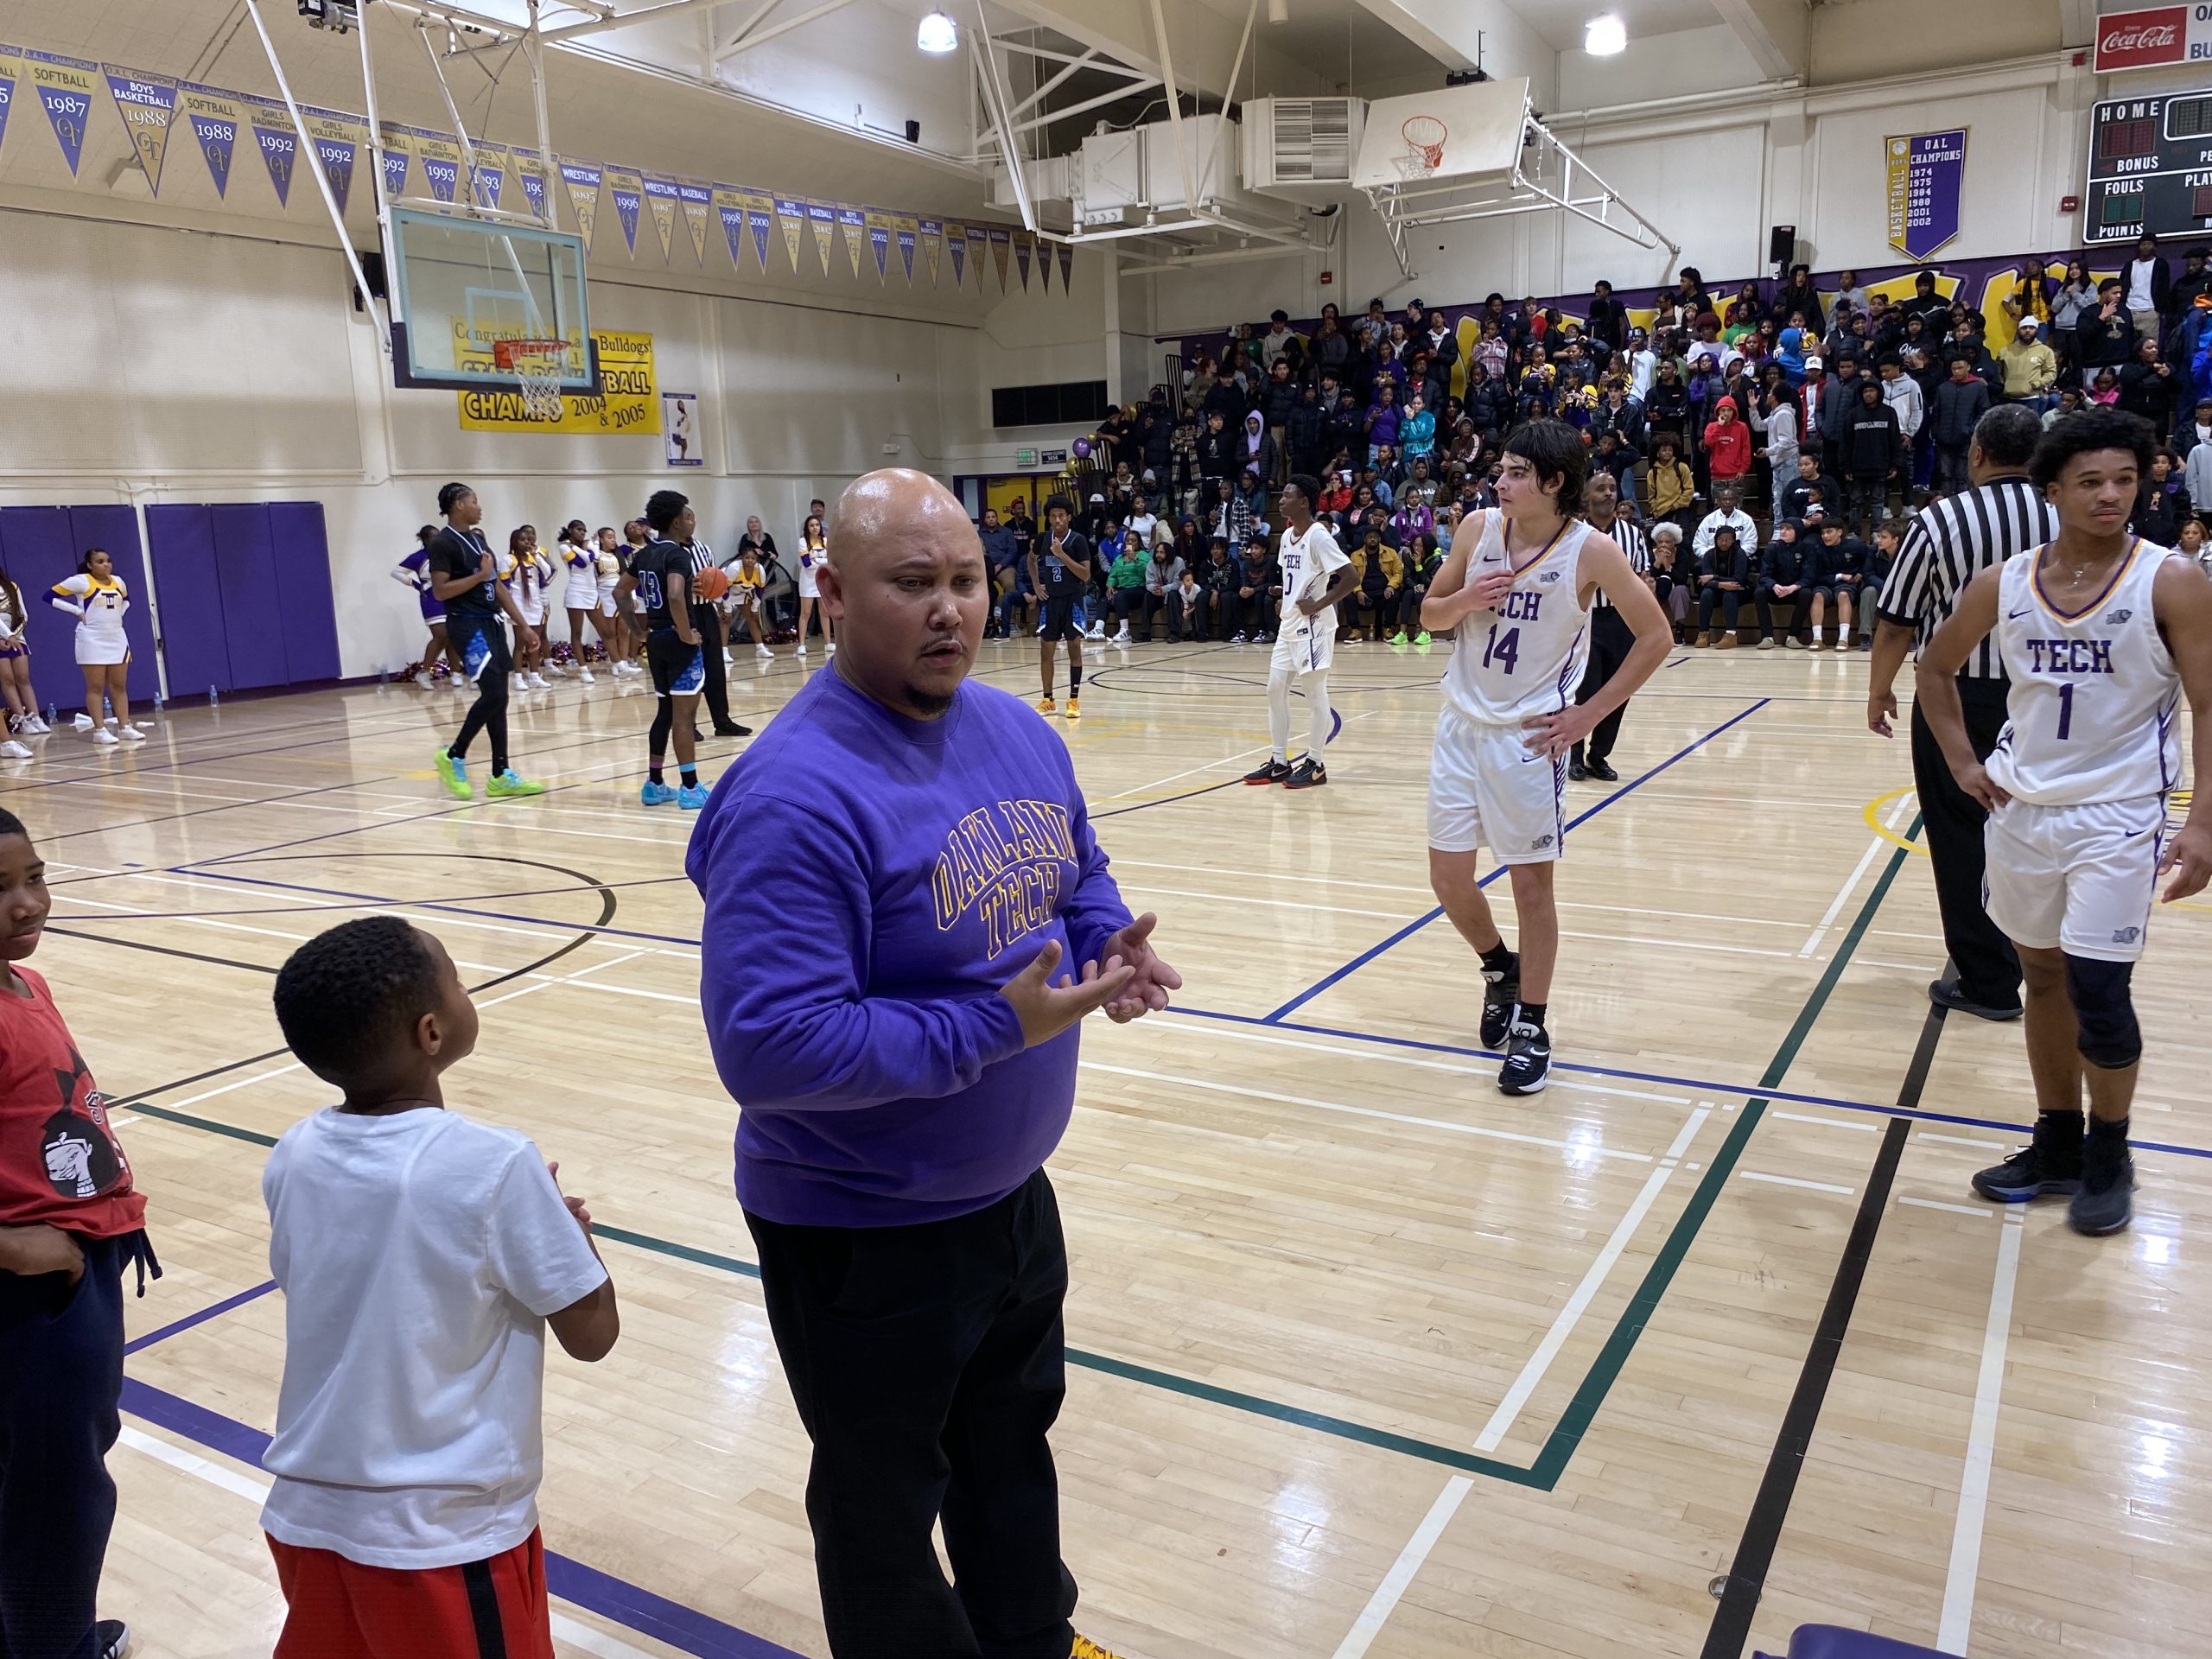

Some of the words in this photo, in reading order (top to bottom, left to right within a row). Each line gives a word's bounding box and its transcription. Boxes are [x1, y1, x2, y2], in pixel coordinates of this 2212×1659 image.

[2101, 24, 2177, 53] Coca-Cola
[50, 54, 95, 71] CHAMPIONS
[35, 67, 89, 88] SOFTBALL
[131, 72, 173, 86] CHAMPIONS
[130, 81, 155, 95] BOYS
[114, 88, 173, 109] BASKETBALL
[46, 96, 86, 118] 1987
[187, 97, 236, 117] SOFTBALL
[2101, 101, 2159, 122] HOME
[128, 109, 166, 128] 1988
[262, 110, 284, 120] GIRLS
[196, 124, 233, 141] 1988
[321, 121, 343, 130] GIRLS
[310, 127, 356, 143] VOLLEYBALL
[261, 136, 294, 152] 1992
[429, 142, 448, 151] GIRLS
[1925, 138, 1948, 150] OAL
[320, 147, 352, 162] 1992
[420, 147, 458, 161] BADMINTON
[1910, 149, 1961, 164] CHAMPIONS
[2117, 156, 2158, 172] BONUS
[428, 165, 454, 182] 1993
[563, 168, 600, 183] WRESTLING
[1910, 168, 1932, 177] 1974
[644, 182, 678, 196] WRESTLING
[1910, 178, 1931, 188] 1975
[2105, 179, 2143, 195] FOULS
[572, 189, 596, 204] 1995
[681, 187, 709, 200] BASEBALL
[617, 197, 639, 210] 1996
[1891, 168, 1904, 238] BASKETBALL
[722, 213, 741, 225] 1998
[777, 207, 804, 218] BASKETBALL
[810, 207, 834, 219] BASEBALL
[1908, 207, 1929, 217] 2001
[749, 216, 769, 227] 2000
[1907, 217, 1931, 226] 2002
[871, 232, 888, 243] 2002
[600, 334, 652, 355] Bulldogs!
[572, 396, 607, 416] 2004
[601, 413, 610, 427] &
[613, 403, 646, 429] 2005
[1052, 567, 1062, 582] 2
[639, 570, 663, 609] 13
[1483, 623, 1520, 675] 14
[2026, 639, 2114, 674] TECH
[2056, 683, 2074, 741] 1
[979, 862, 1060, 961] TECH
